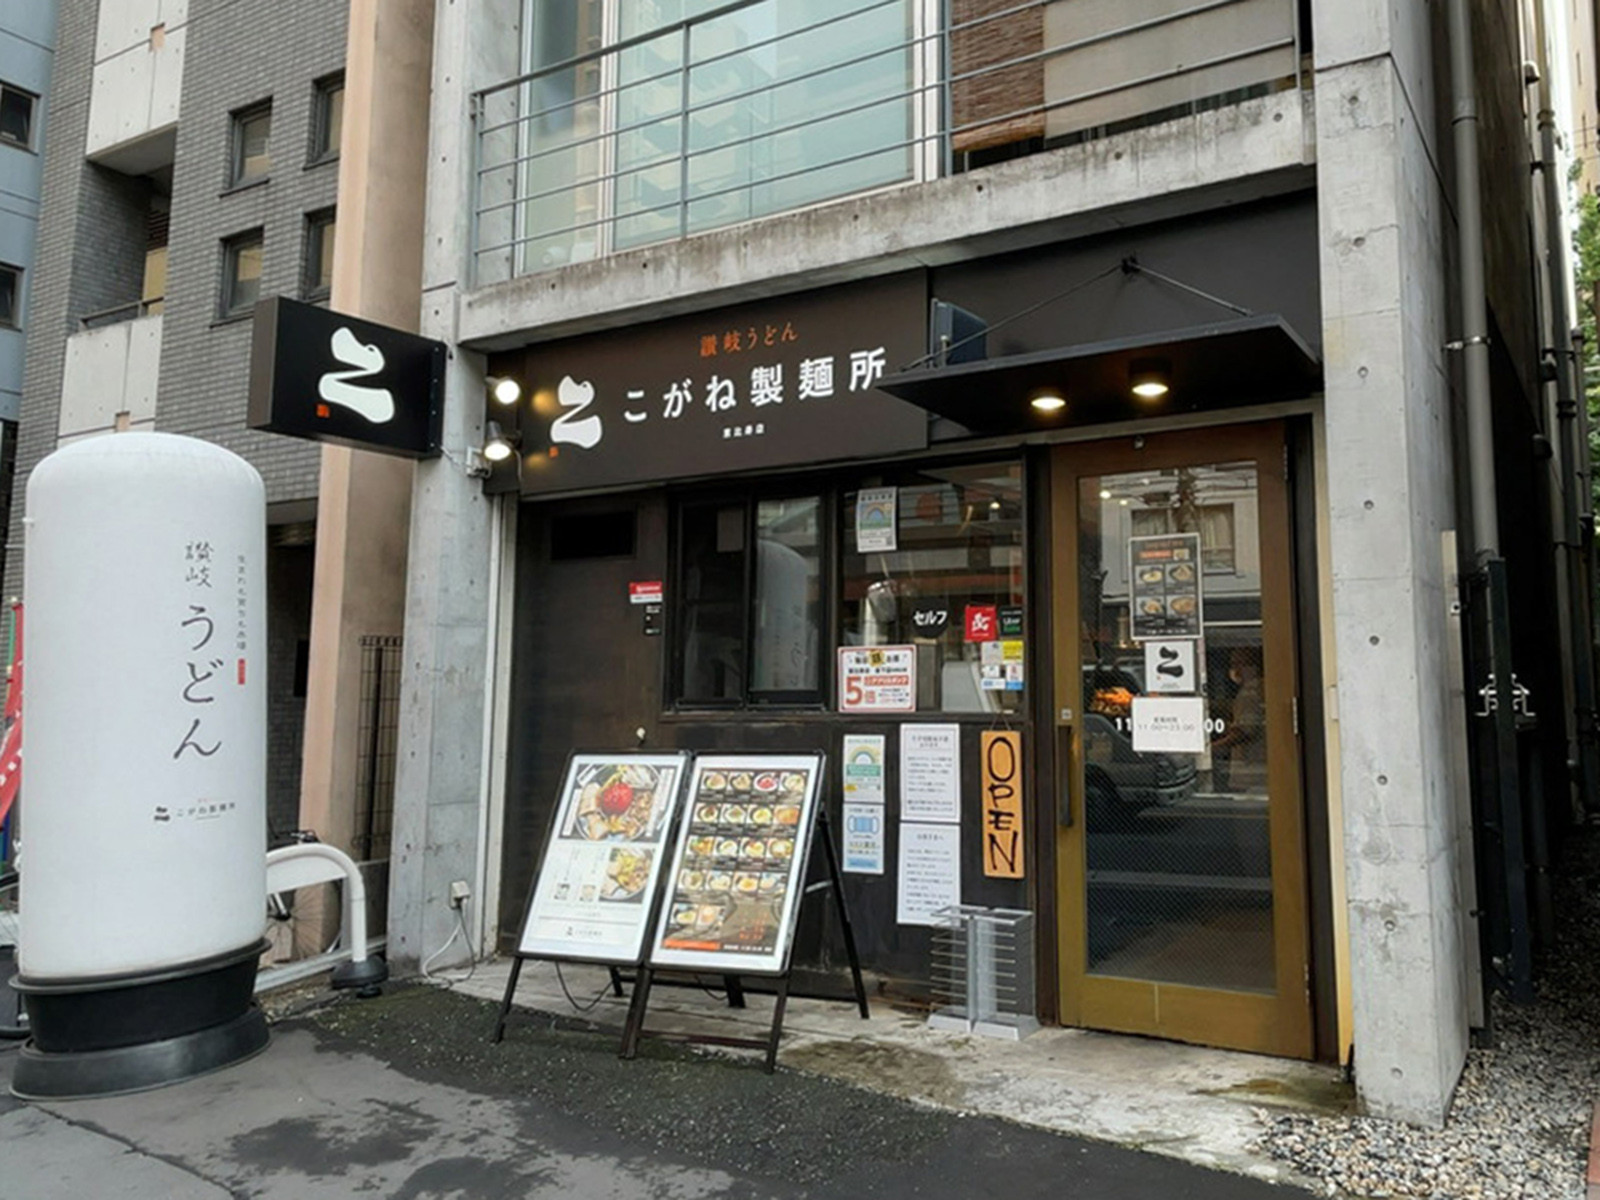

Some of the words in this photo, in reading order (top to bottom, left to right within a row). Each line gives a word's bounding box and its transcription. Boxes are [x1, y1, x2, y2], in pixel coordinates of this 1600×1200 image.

[701, 321, 798, 356] 讃岐うどん
[624, 347, 885, 422] こがね製麺所
[173, 541, 224, 760] 讃岐うどん
[913, 610, 948, 626] セルフ
[987, 736, 1018, 873] OPEN
